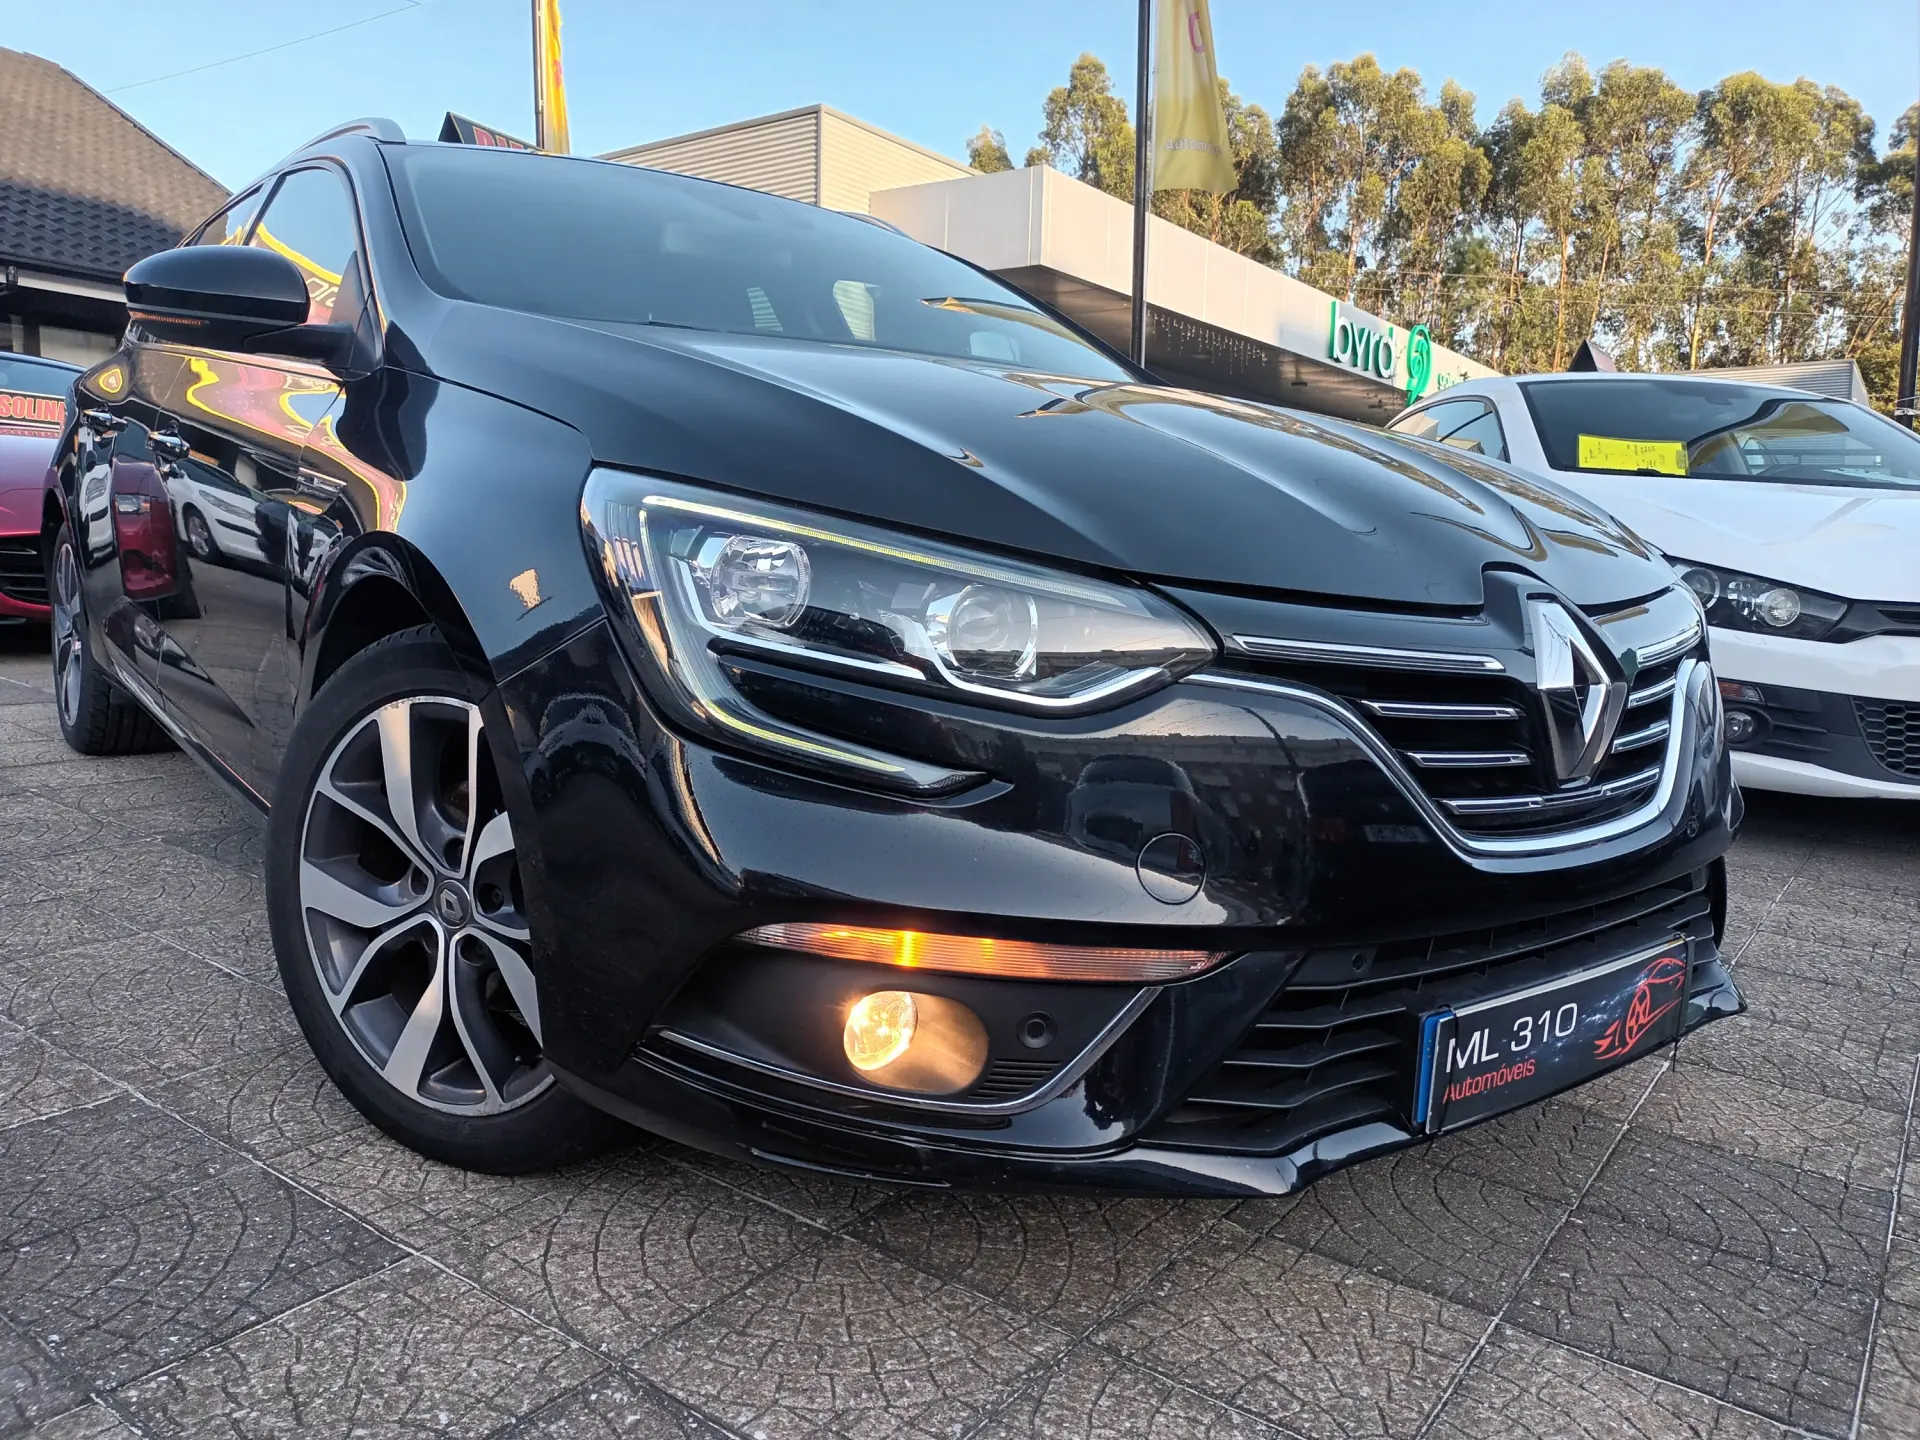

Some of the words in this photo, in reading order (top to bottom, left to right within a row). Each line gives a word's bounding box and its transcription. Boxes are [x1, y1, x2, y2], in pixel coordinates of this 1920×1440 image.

[1329, 300, 1396, 379] byrd
[1446, 1028, 1499, 1073] ML
[1511, 1002, 1578, 1052] 310
[1443, 1058, 1536, 1104] Automóveis
